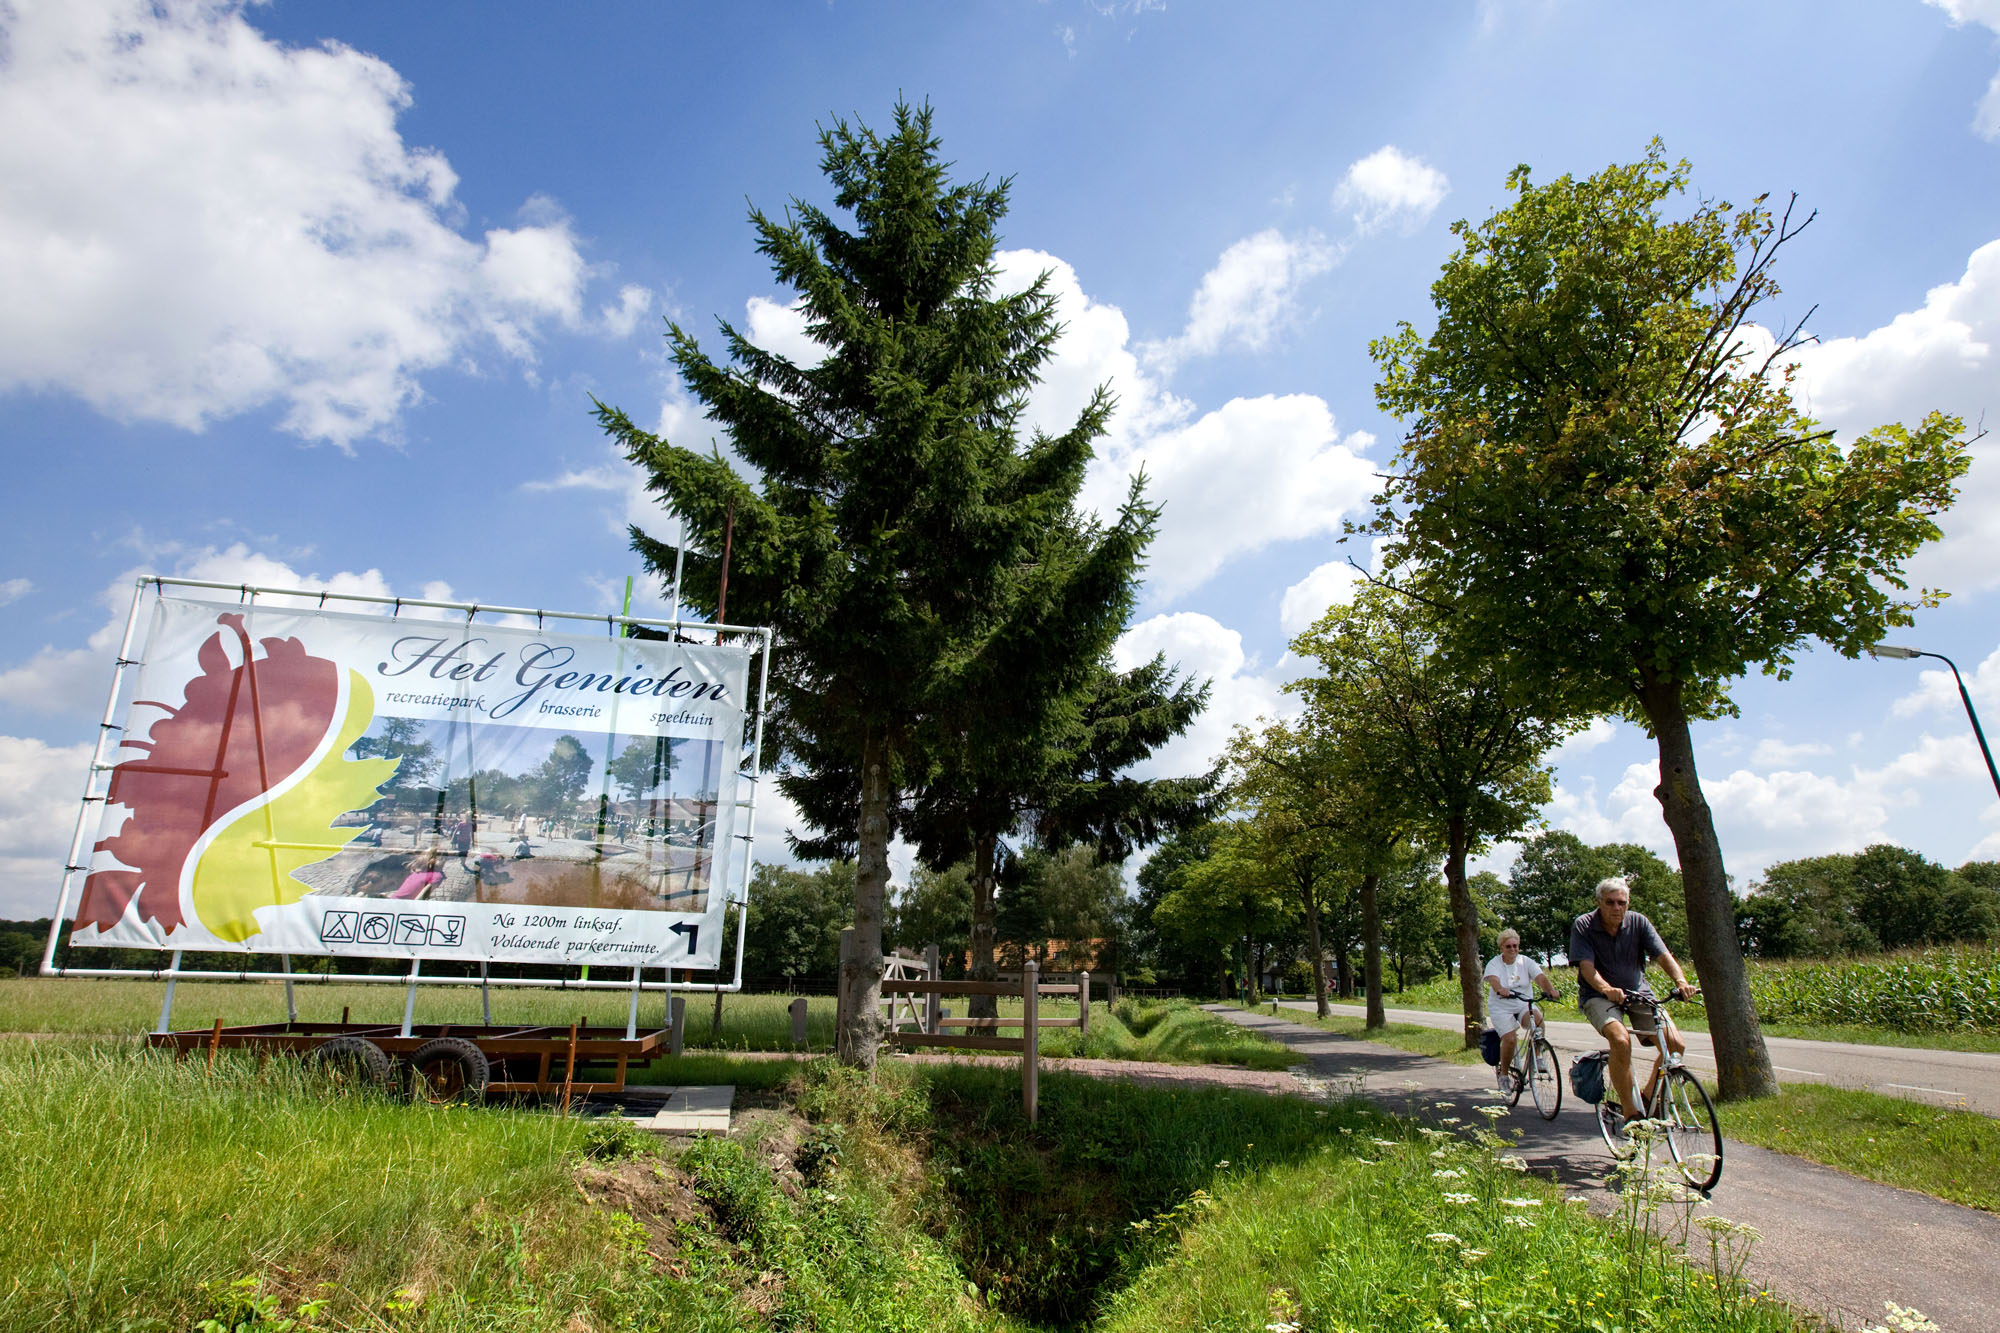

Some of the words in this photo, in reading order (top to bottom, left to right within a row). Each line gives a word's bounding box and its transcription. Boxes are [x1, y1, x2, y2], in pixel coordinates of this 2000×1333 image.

[377, 636, 506, 682] Het
[489, 642, 730, 720] Genieten
[386, 689, 488, 712] recreatiepark
[538, 699, 601, 719] brasserie
[649, 709, 713, 727] speeltuin
[492, 913, 515, 928] Na
[523, 914, 567, 928] 1200m
[572, 916, 623, 933] linksaf.
[491, 934, 560, 950] Voldoende
[565, 938, 661, 955] parkeerruimte.
